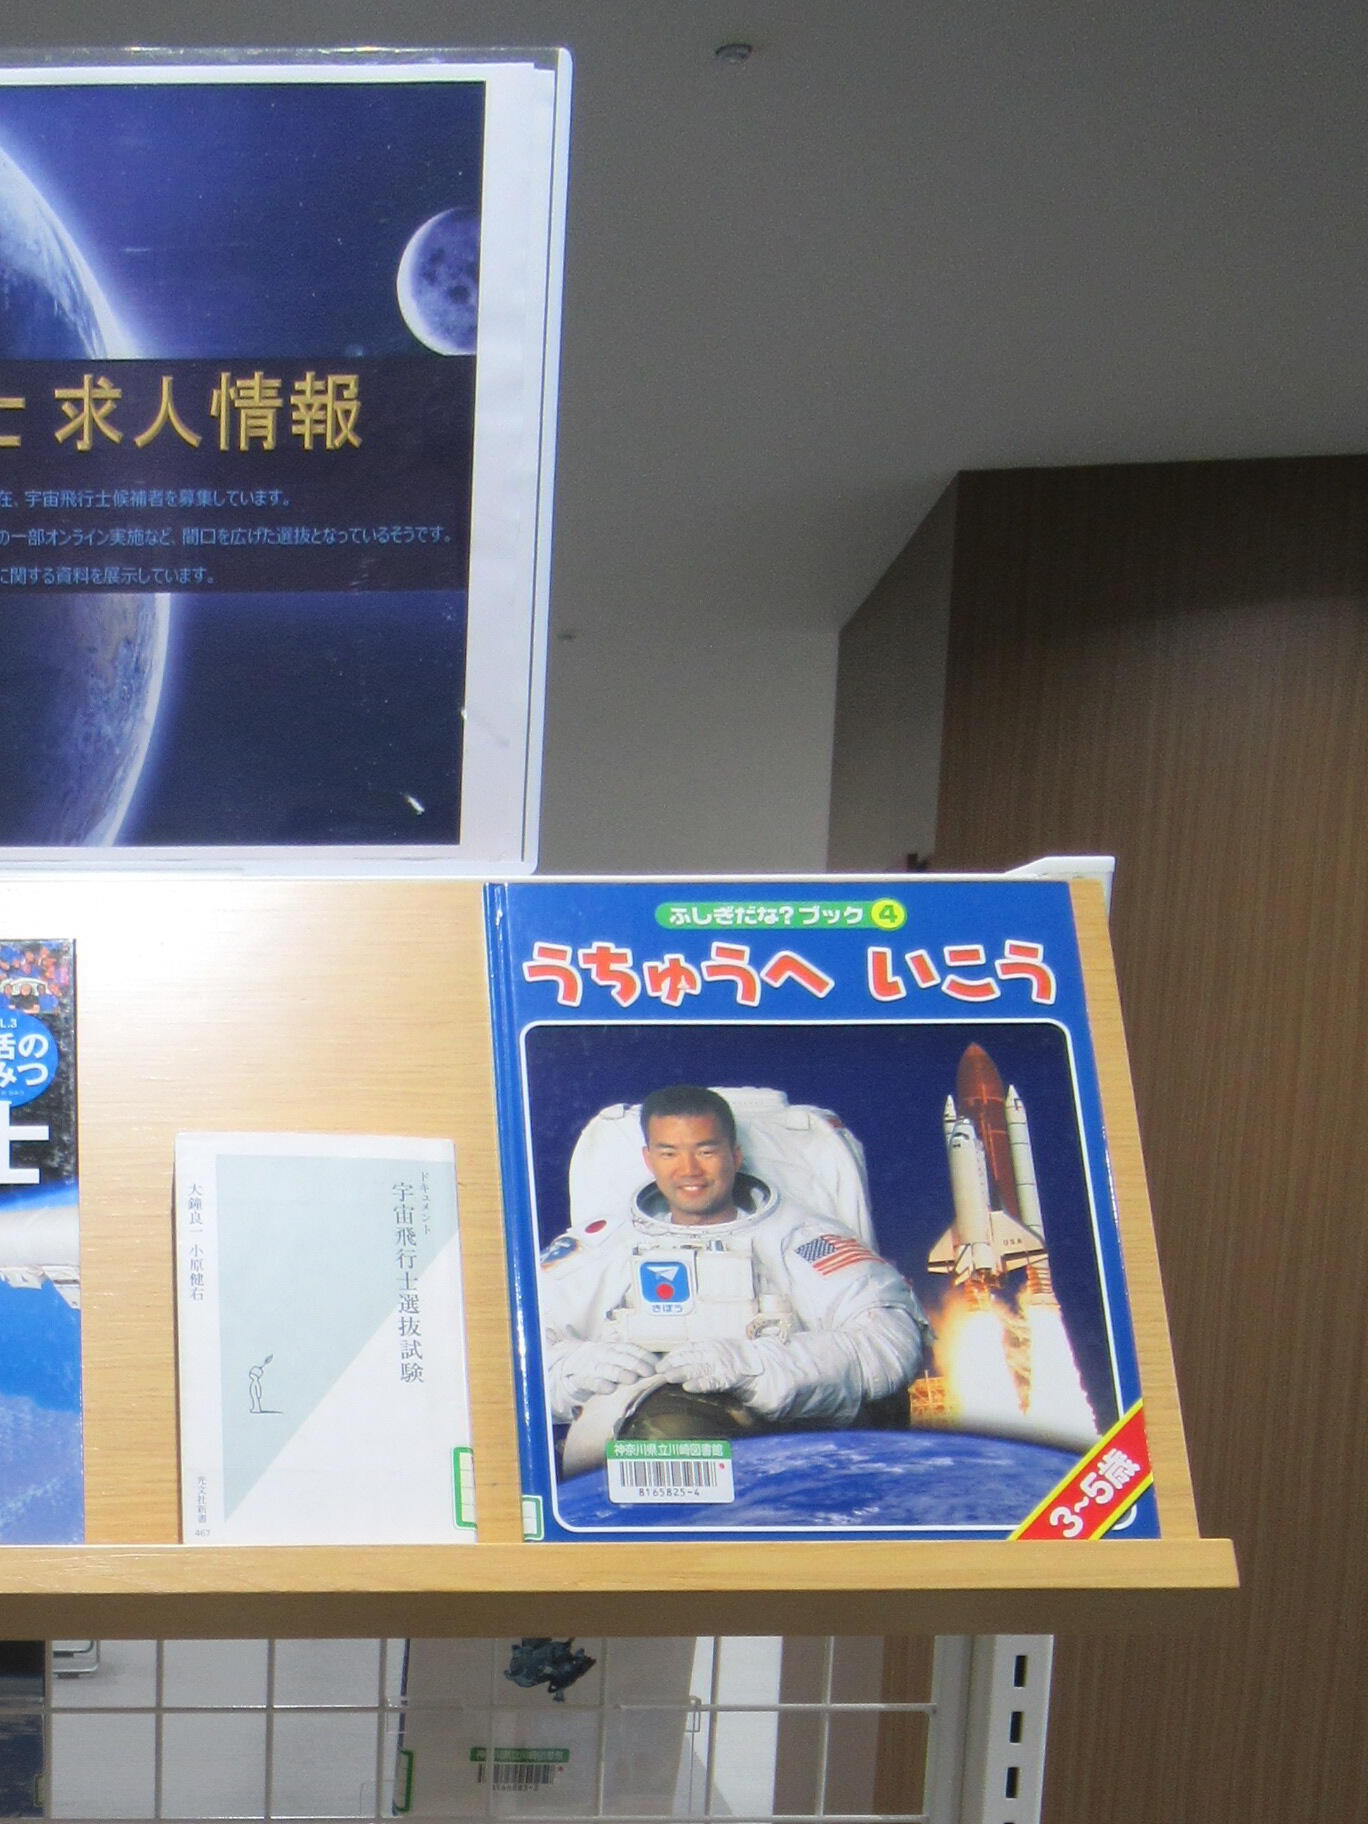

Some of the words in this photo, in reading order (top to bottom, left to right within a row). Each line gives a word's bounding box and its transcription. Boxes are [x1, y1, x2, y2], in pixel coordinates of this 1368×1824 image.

[54, 372, 364, 452] 求人情報
[522, 940, 834, 1007] うちゅうへ
[867, 938, 1056, 1005] いこう
[420, 1171, 432, 1235] ドキュメント
[393, 1181, 424, 1384] 宇宙飛行士選抜試験
[651, 1303, 683, 1313] きぼう
[639, 1487, 700, 1497] 8165825-4
